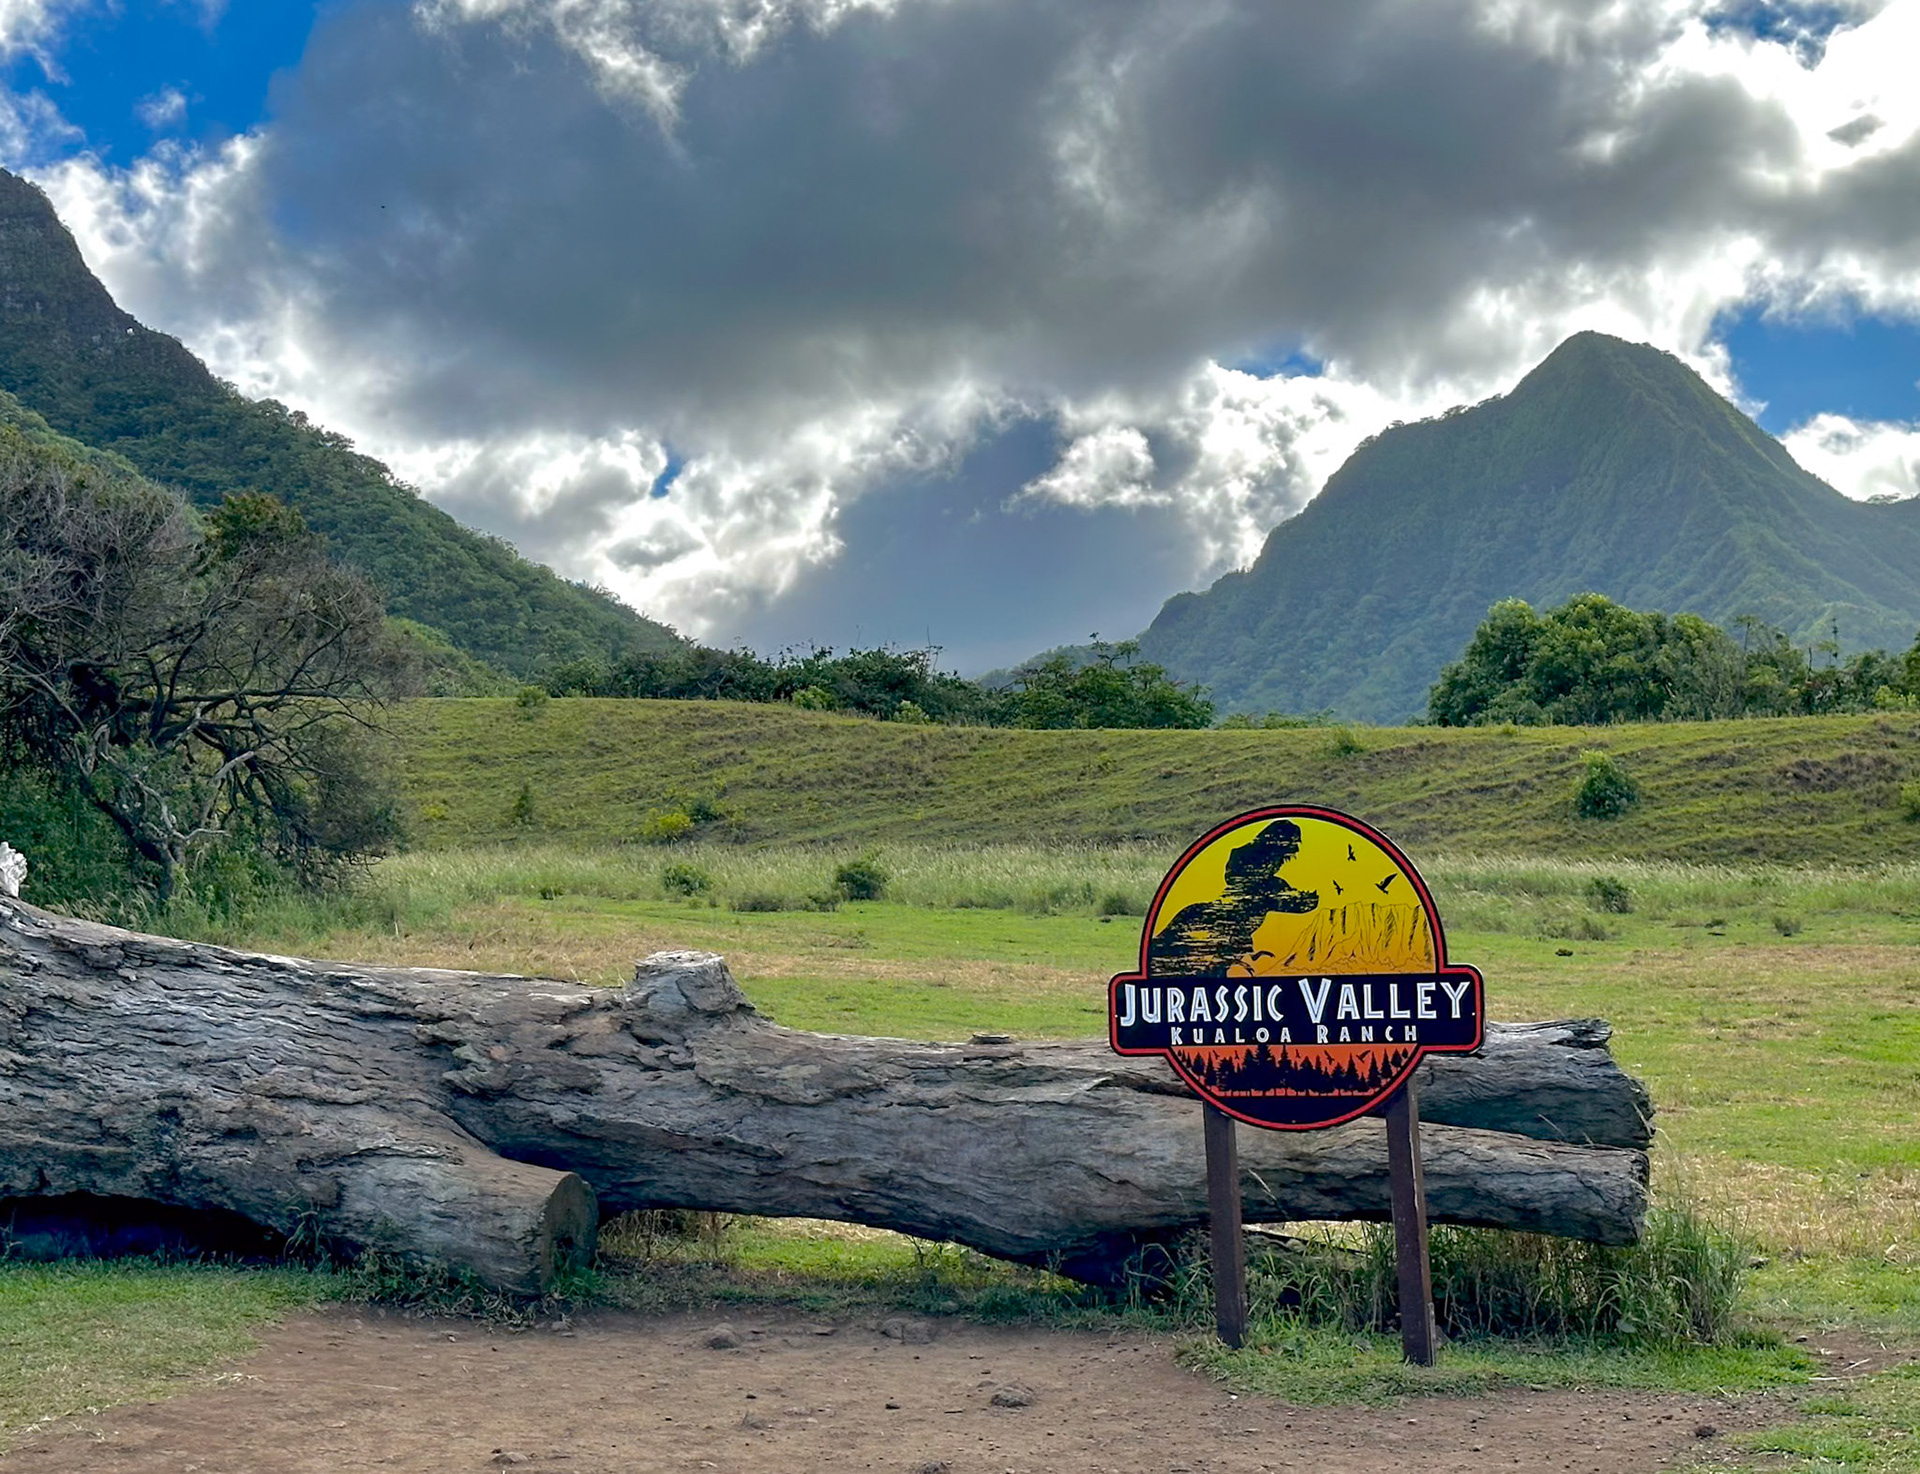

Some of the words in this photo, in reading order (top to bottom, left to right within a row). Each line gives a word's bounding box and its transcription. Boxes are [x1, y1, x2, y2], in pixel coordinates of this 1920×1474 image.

[1120, 984, 1284, 1027] JURASSIC
[1298, 978, 1471, 1024] VALLEY
[1170, 1026, 1292, 1046] KUALOA
[1316, 1024, 1417, 1044] RANCH
